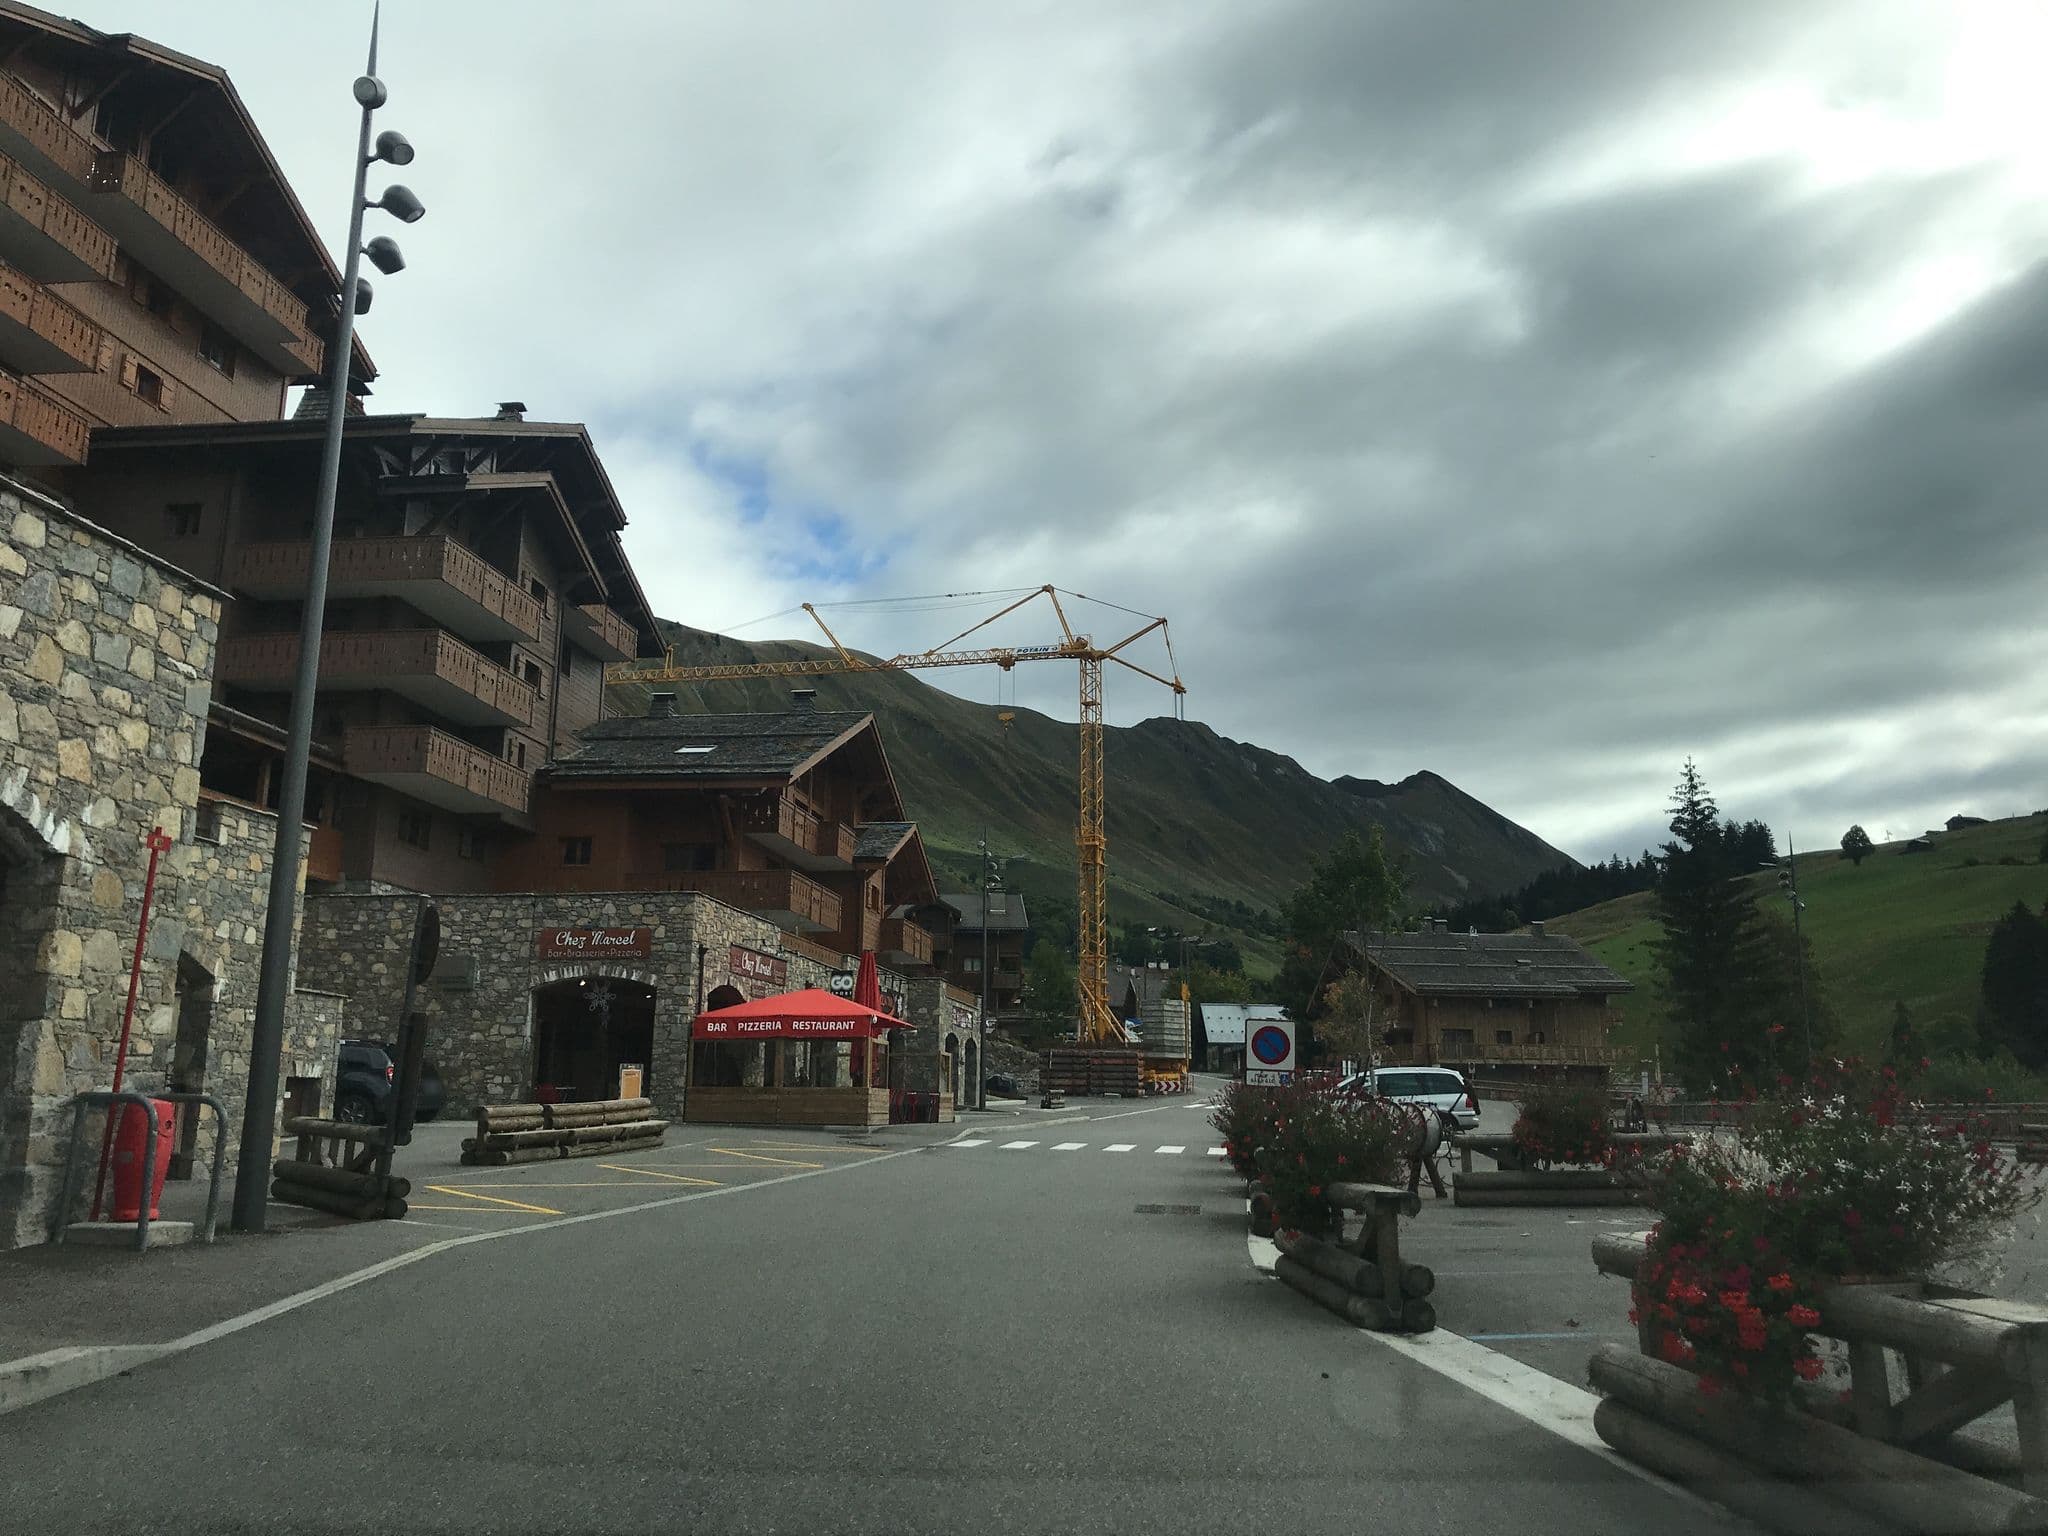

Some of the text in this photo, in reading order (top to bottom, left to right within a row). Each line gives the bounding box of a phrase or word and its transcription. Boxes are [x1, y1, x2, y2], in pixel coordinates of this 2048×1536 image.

[555, 930, 636, 949] Chez Marcel
[831, 974, 853, 990] GO
[706, 1020, 856, 1032] BAR PIZZERIA RESTAURANT
